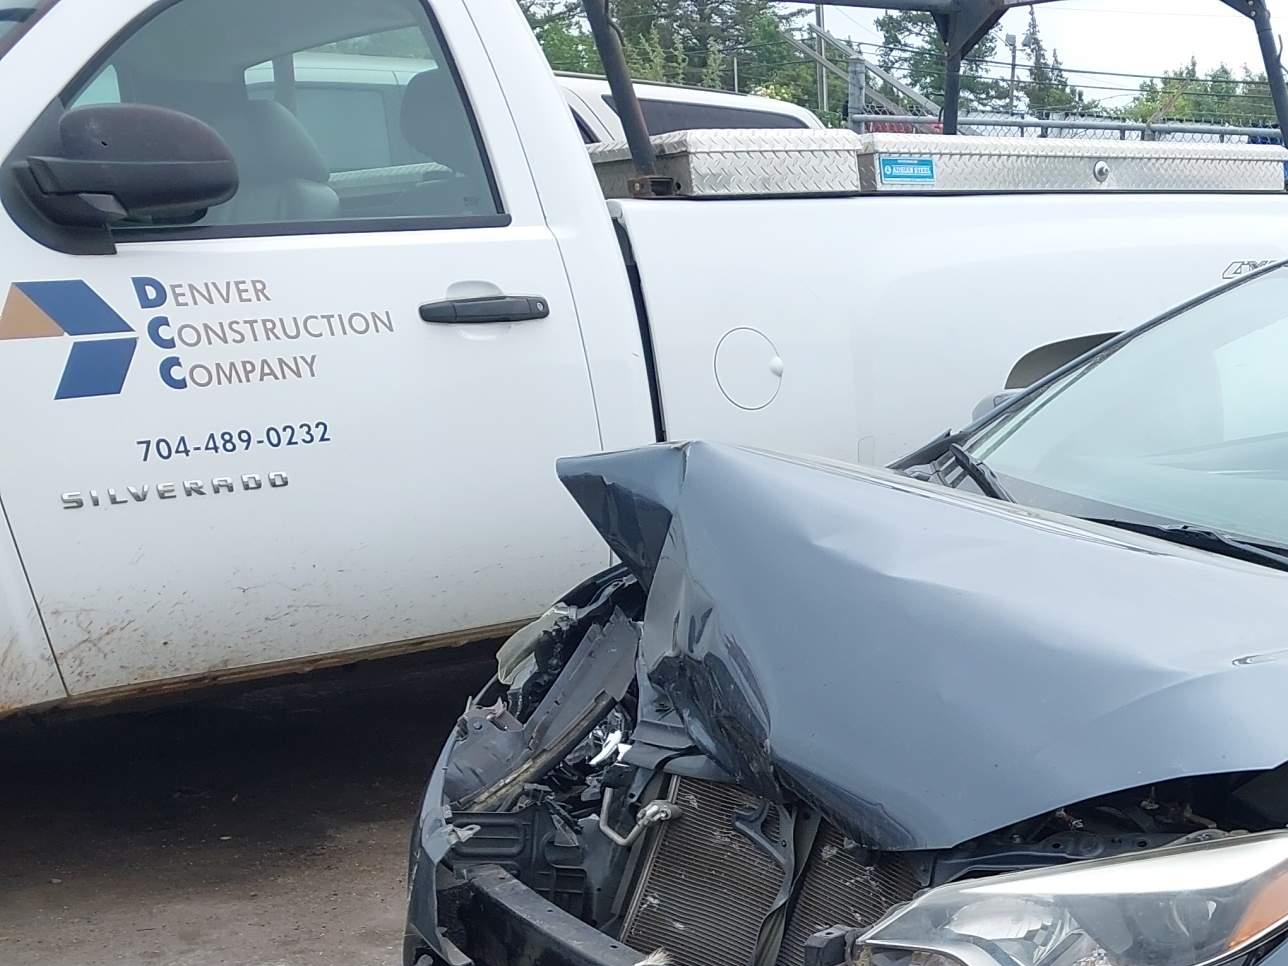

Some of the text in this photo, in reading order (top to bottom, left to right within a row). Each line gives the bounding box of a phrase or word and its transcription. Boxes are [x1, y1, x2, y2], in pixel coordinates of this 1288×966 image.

[130, 276, 271, 309] DENVER
[147, 310, 395, 349] CONSTRUCTION
[159, 354, 317, 390] COMPANY
[136, 421, 331, 462] 704-489-0232
[60, 470, 289, 510] SILVERADO
